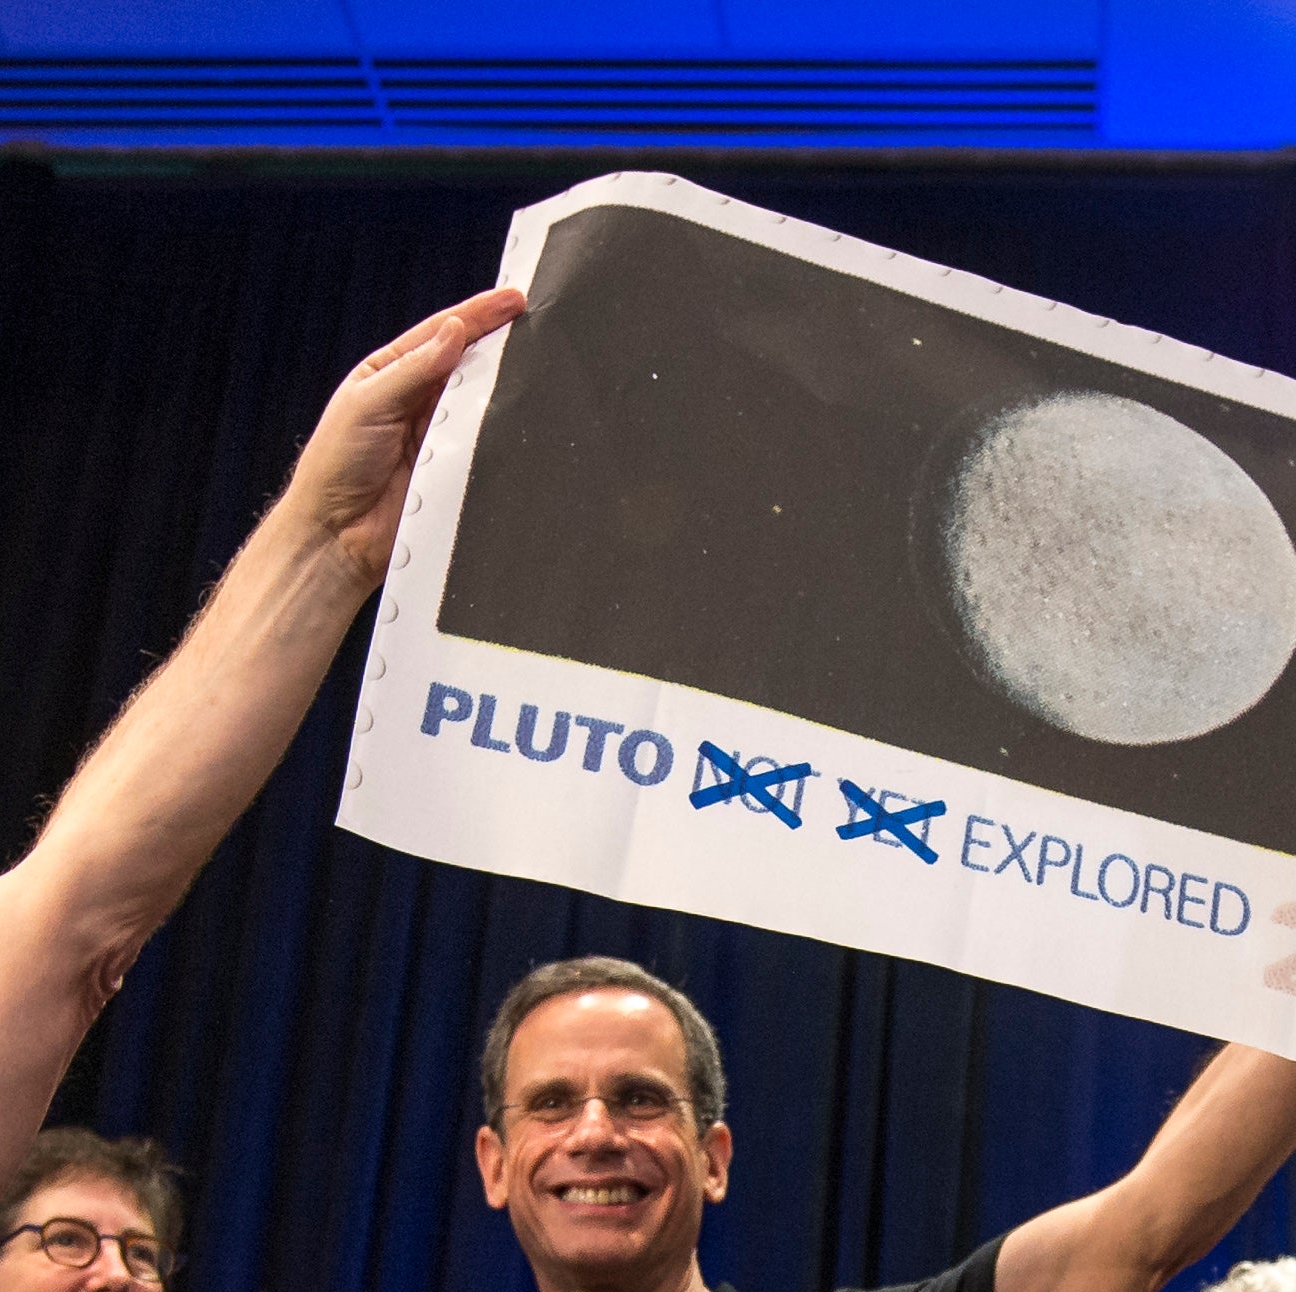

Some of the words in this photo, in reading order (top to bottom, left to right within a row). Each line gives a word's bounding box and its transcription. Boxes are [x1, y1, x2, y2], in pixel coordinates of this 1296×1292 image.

[420, 680, 675, 786] PLUTO
[691, 748, 821, 818] NOT
[837, 775, 944, 852] YET
[960, 813, 1251, 937] EXPLORED
